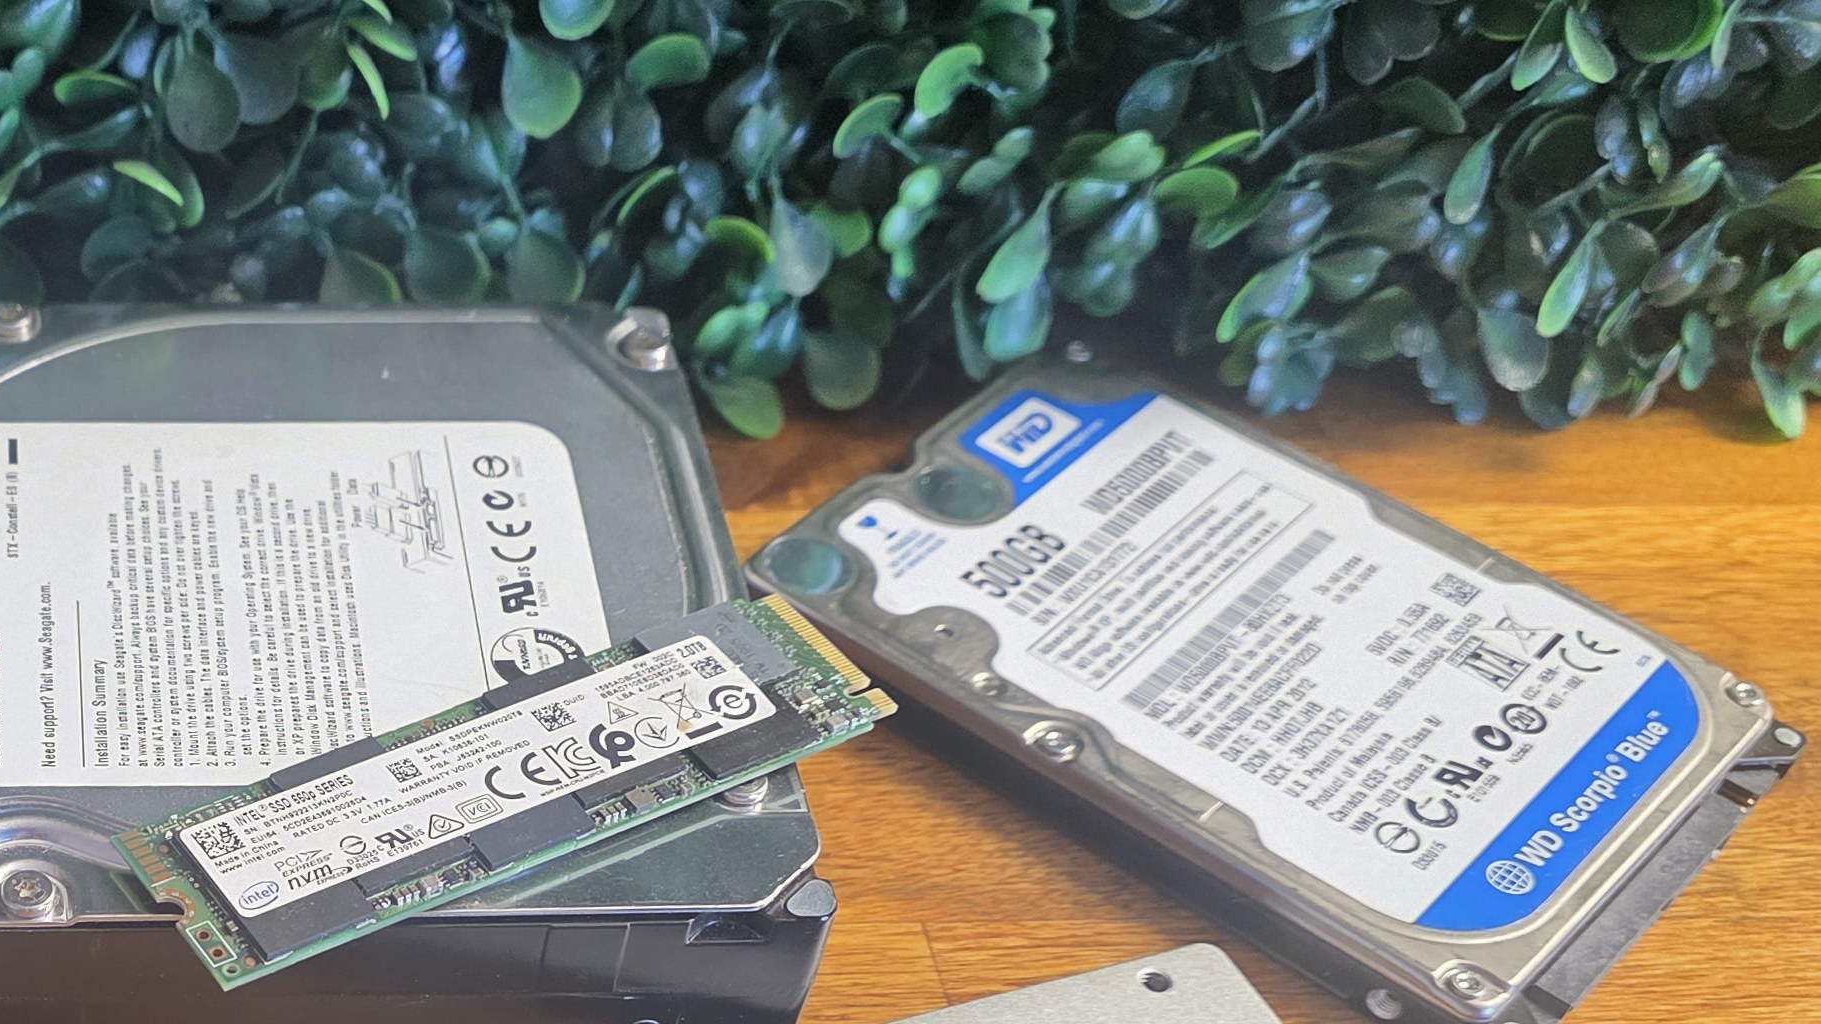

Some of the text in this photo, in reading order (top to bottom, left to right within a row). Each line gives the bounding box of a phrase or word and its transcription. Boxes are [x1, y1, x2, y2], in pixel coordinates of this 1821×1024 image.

[960, 524, 1066, 598] 500GB
[675, 640, 707, 659] 2.0TB
[39, 672, 54, 693] Visit
[116, 671, 126, 685] use
[39, 695, 59, 736] support?
[91, 658, 109, 767] Installation Summary
[114, 687, 128, 730] installation
[149, 680, 166, 766] Serial ATA controllers
[184, 692, 200, 755] Mount the drive
[204, 715, 215, 728] the
[219, 679, 236, 756] Run your computer
[253, 686, 271, 755] Prepare the drive
[41, 741, 56, 767] Need
[119, 733, 132, 750] easy
[205, 730, 218, 756] Attach
[118, 752, 131, 766] For
[397, 739, 531, 794] WARRANTY VOID IF REMOVED
[1304, 731, 1394, 811] Product of Malaysia
[267, 796, 292, 813] SSD
[290, 789, 317, 805] 660p
[314, 773, 354, 796] SERIES
[1326, 790, 1369, 823] Canada
[291, 822, 325, 839] RATED
[324, 816, 341, 826] DC
[359, 812, 382, 824] CAN
[213, 839, 279, 867] Made in China
[354, 855, 381, 870] RoHS
[1513, 829, 1563, 867] WD
